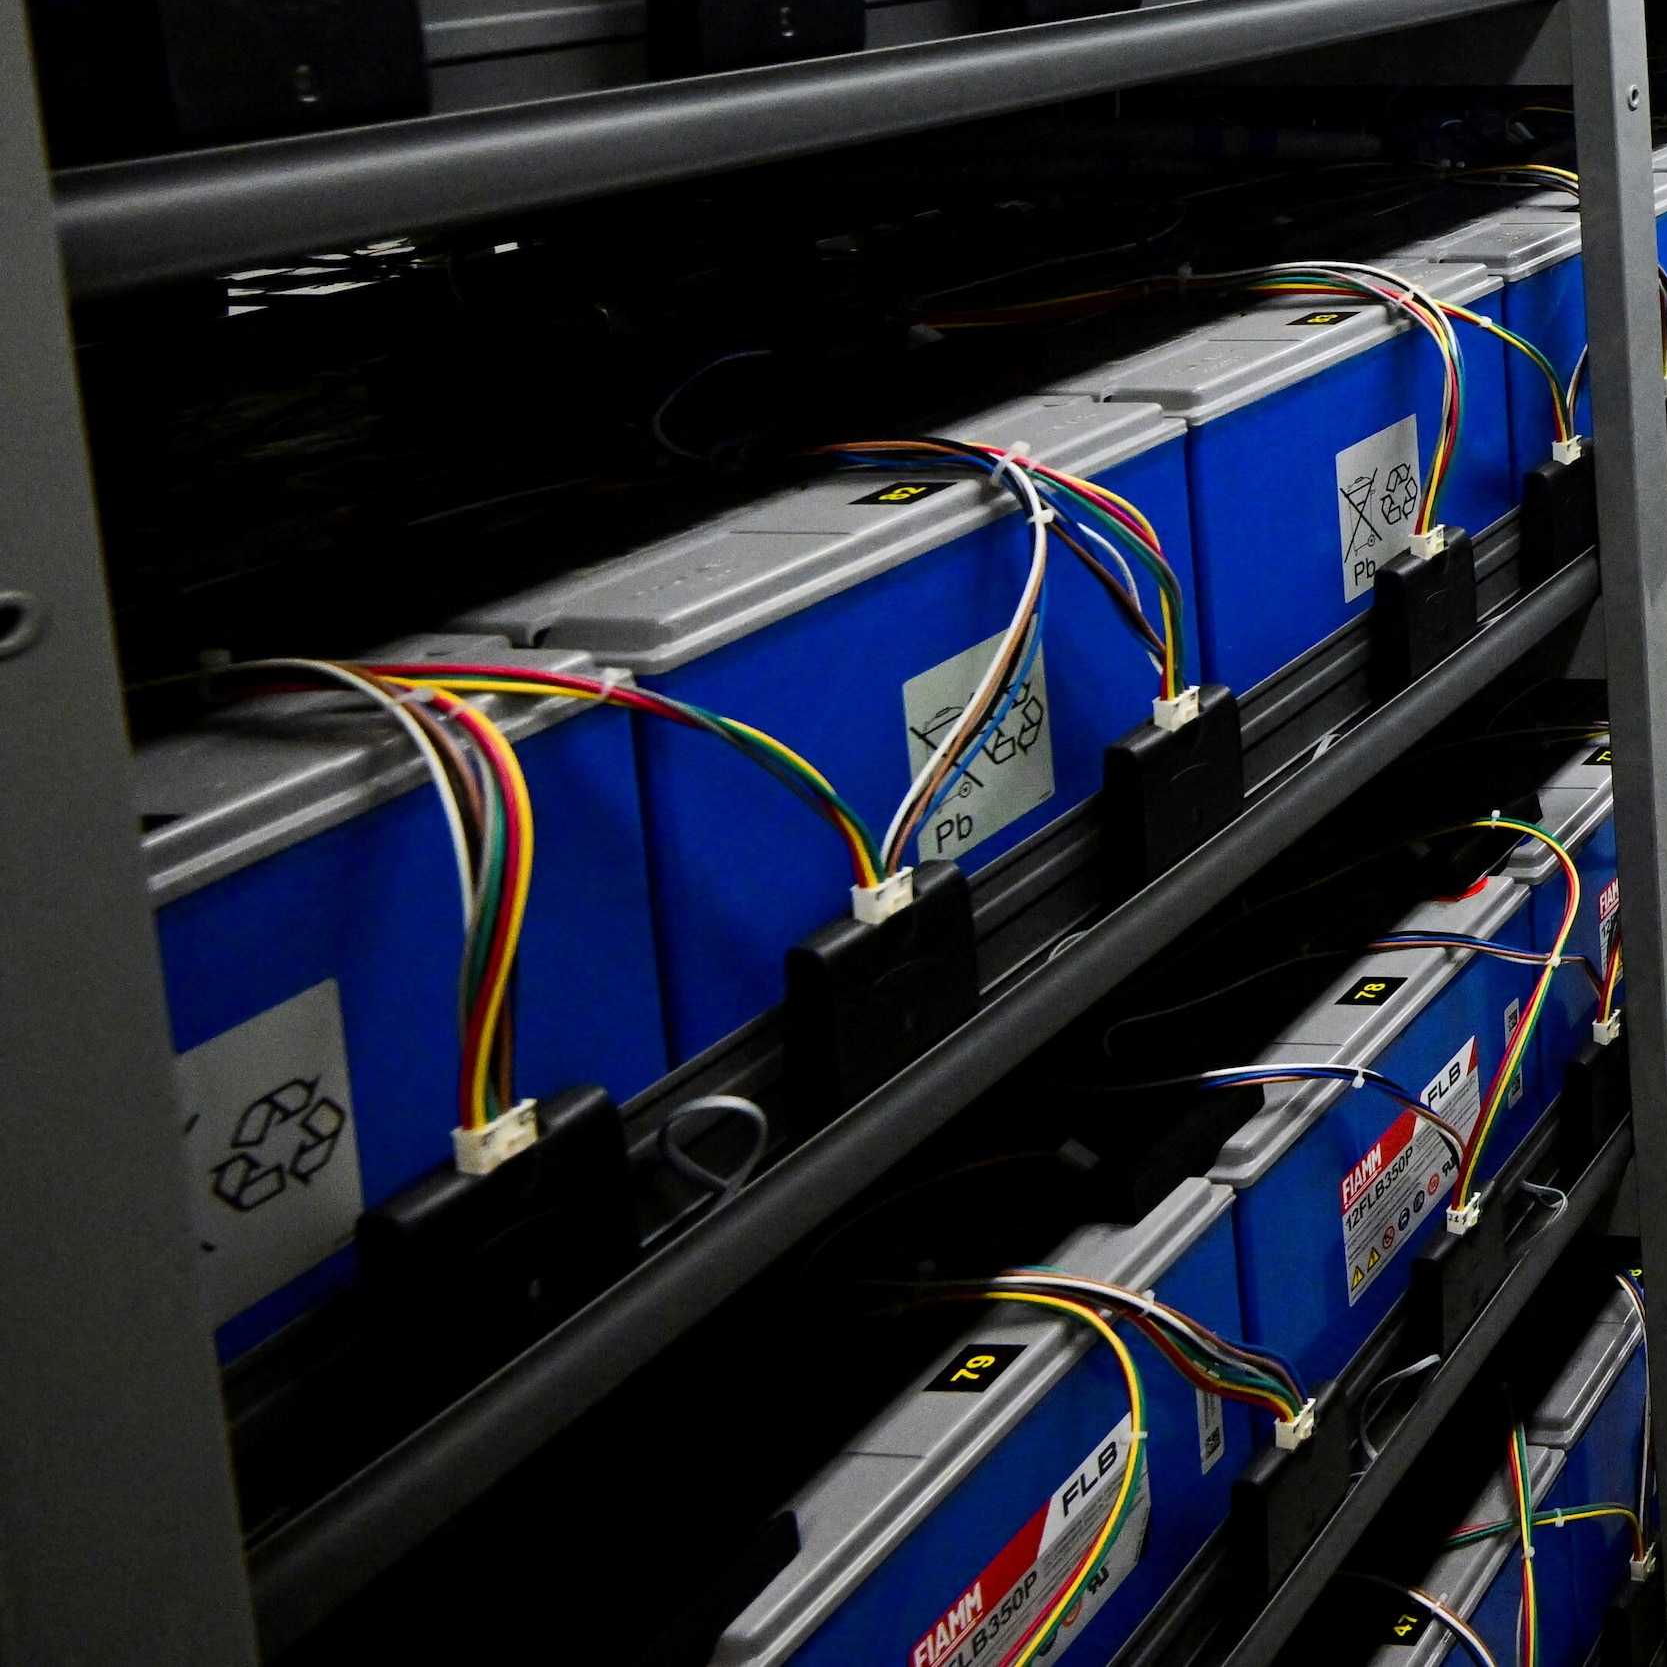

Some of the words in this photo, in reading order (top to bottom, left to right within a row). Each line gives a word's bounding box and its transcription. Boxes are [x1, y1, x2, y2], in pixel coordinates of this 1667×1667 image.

[1354, 557, 1377, 586] Pb
[936, 813, 973, 854] Pb
[1599, 878, 1620, 916] FIAM
[1354, 982, 1386, 1000] 78
[1427, 1061, 1461, 1109] FLB
[1342, 1142, 1383, 1205] FIAMM
[1345, 1145, 1414, 1232] 12FLB350P
[950, 1354, 995, 1386] 79
[1062, 1440, 1118, 1518] FLB
[913, 1580, 983, 1667] FIAMM
[1393, 1613, 1418, 1637] 47
